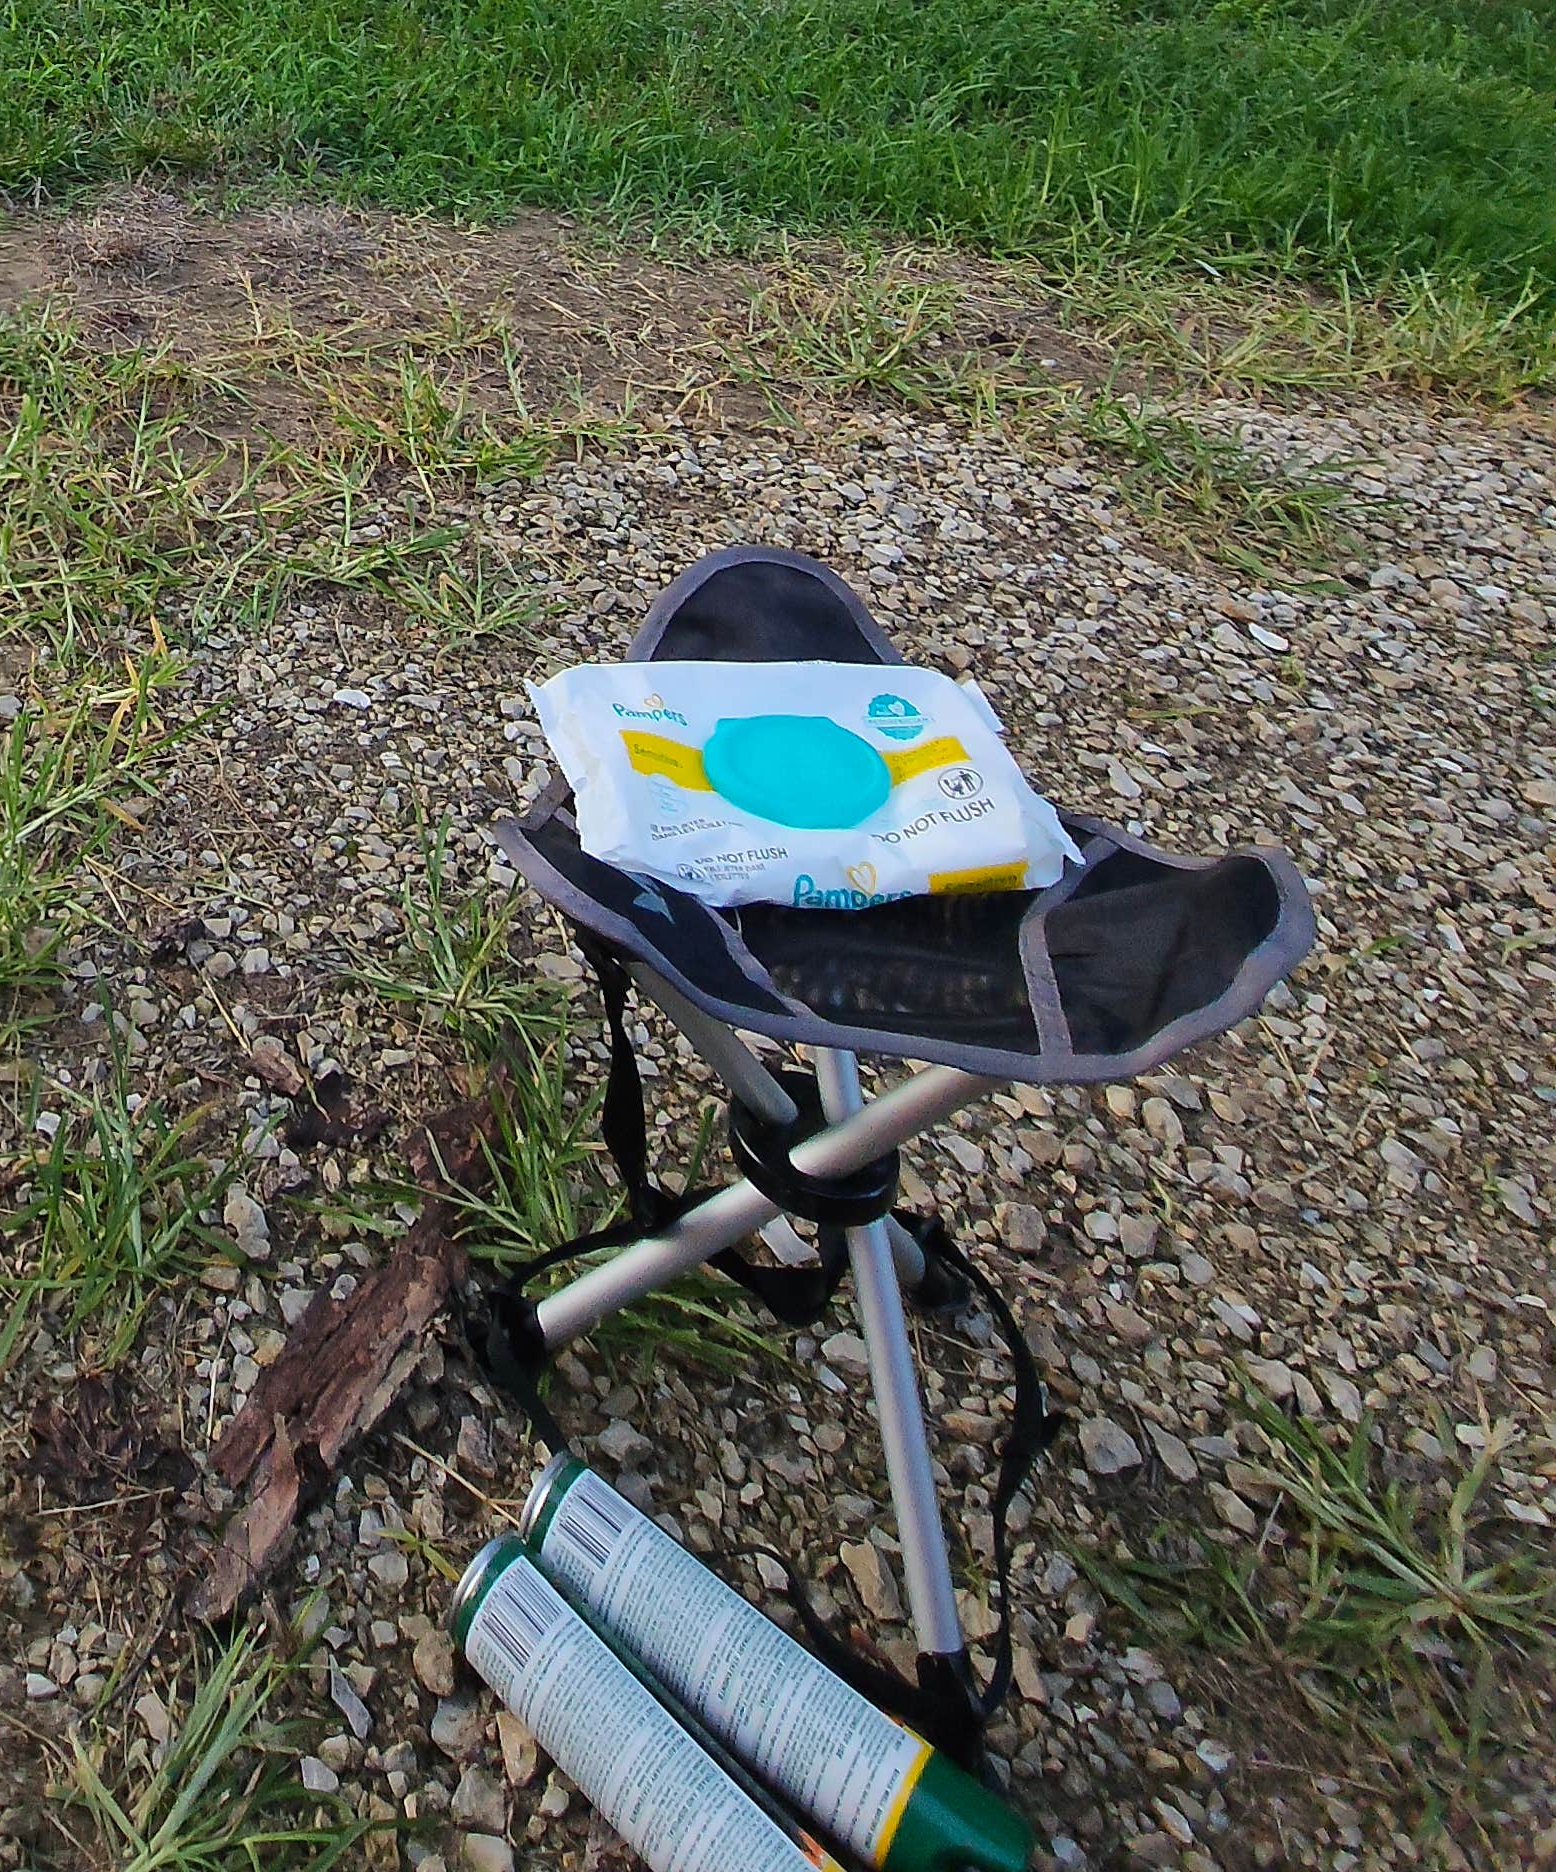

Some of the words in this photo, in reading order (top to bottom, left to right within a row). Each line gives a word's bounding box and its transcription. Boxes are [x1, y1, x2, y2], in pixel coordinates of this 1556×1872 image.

[611, 702, 688, 727] Pampers
[903, 813, 938, 840] NOT
[938, 797, 996, 824] FLUSH
[694, 855, 715, 866] DO
[716, 852, 745, 864] NOT
[747, 847, 789, 863] FLUSH
